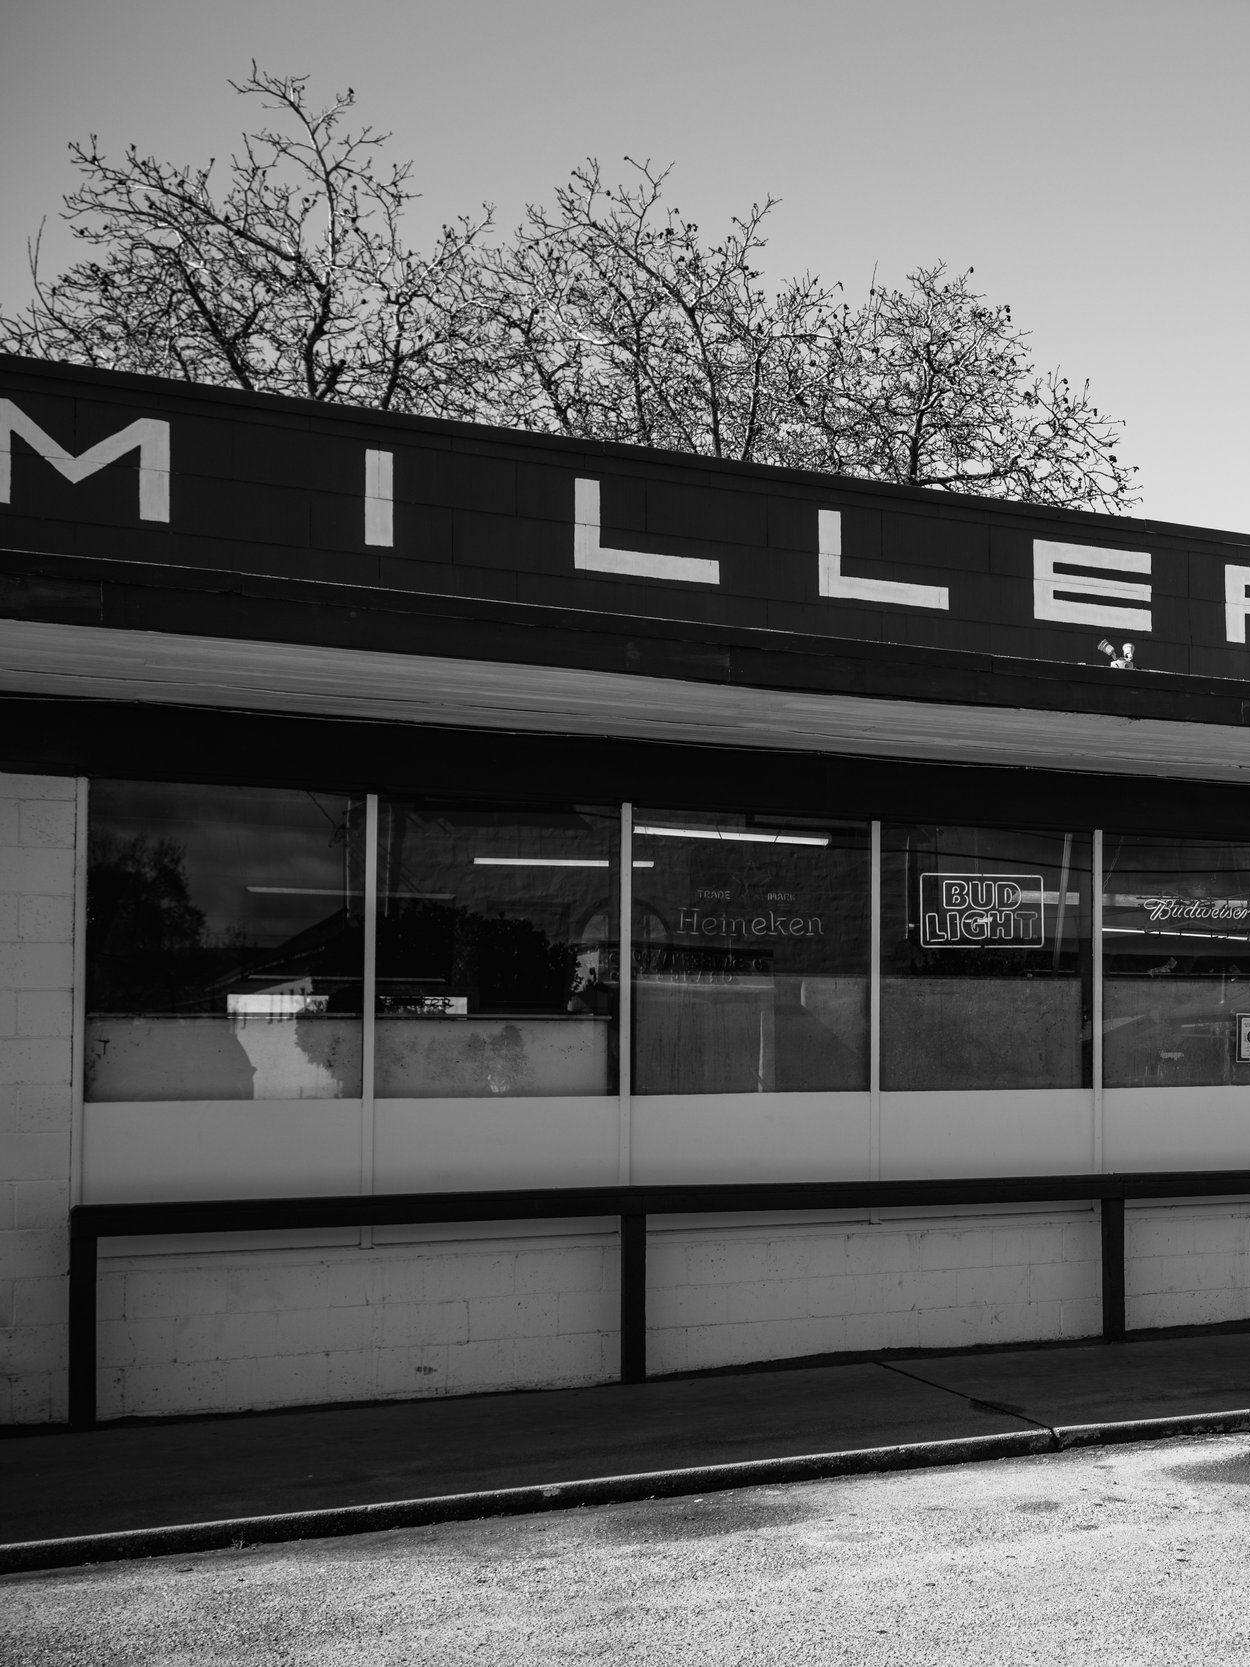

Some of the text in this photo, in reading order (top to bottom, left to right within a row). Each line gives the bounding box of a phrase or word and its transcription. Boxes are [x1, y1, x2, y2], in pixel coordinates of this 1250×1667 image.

[697, 889, 731, 900] TRADE
[943, 880, 1022, 910] BUD
[676, 907, 825, 937] Heineken
[926, 910, 1038, 942] LIGHT
